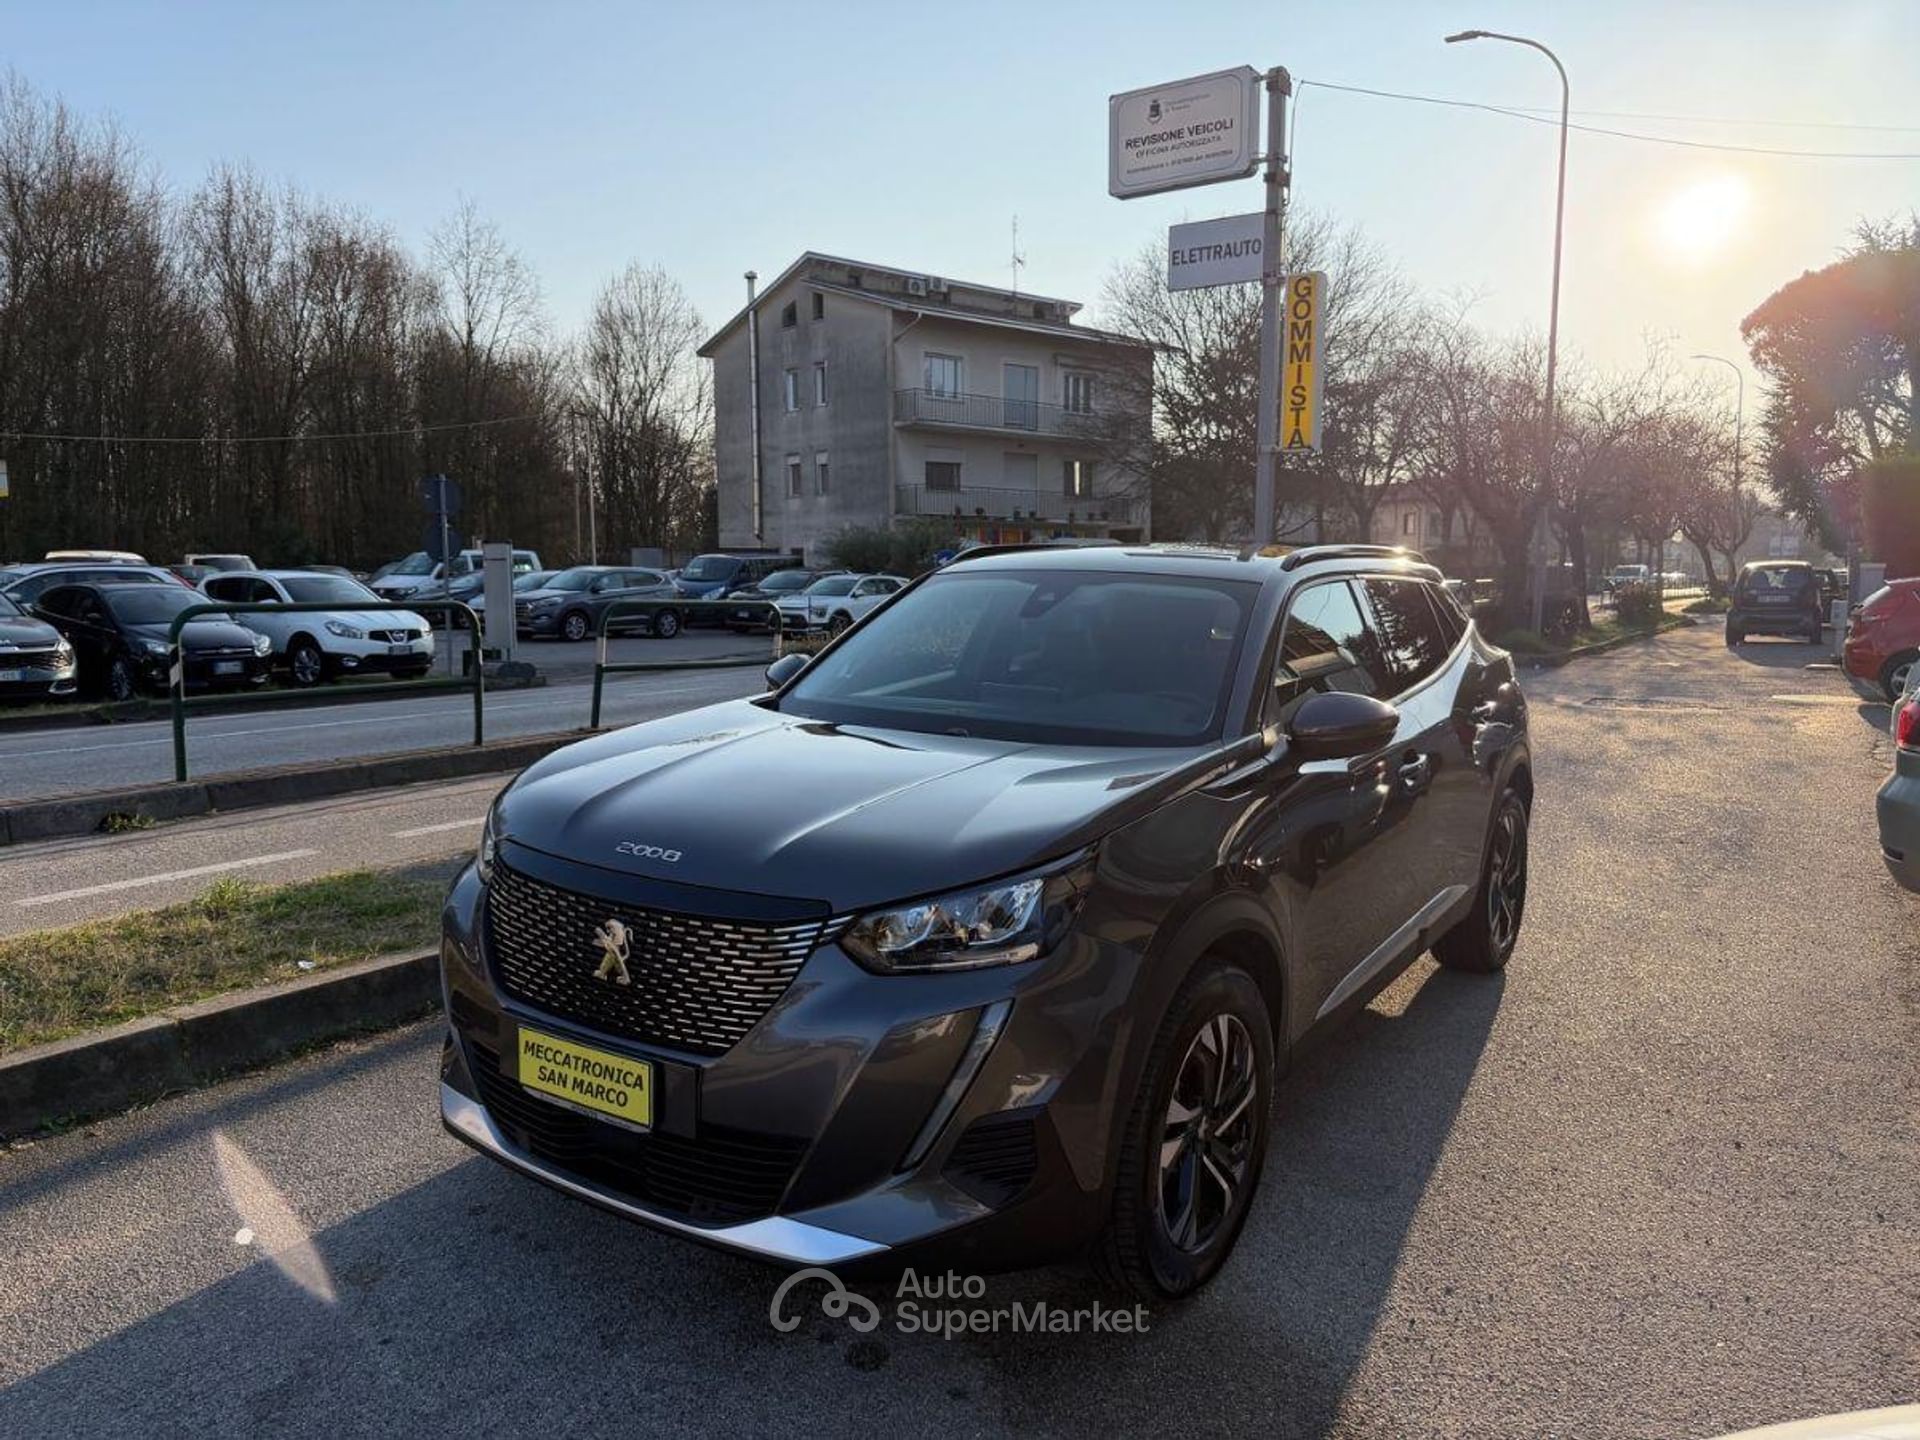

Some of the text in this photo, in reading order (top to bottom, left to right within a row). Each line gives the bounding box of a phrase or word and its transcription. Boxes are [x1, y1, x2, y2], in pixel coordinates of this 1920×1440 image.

[1125, 118, 1234, 150] REVISIONE VEICOLI
[1171, 238, 1262, 267] ELETTRAUTO
[1287, 276, 1313, 450] GOMMISTA
[615, 841, 682, 862] 2008
[523, 1040, 644, 1091] MECCATRONICA
[537, 1065, 628, 1107] SAN MARCO
